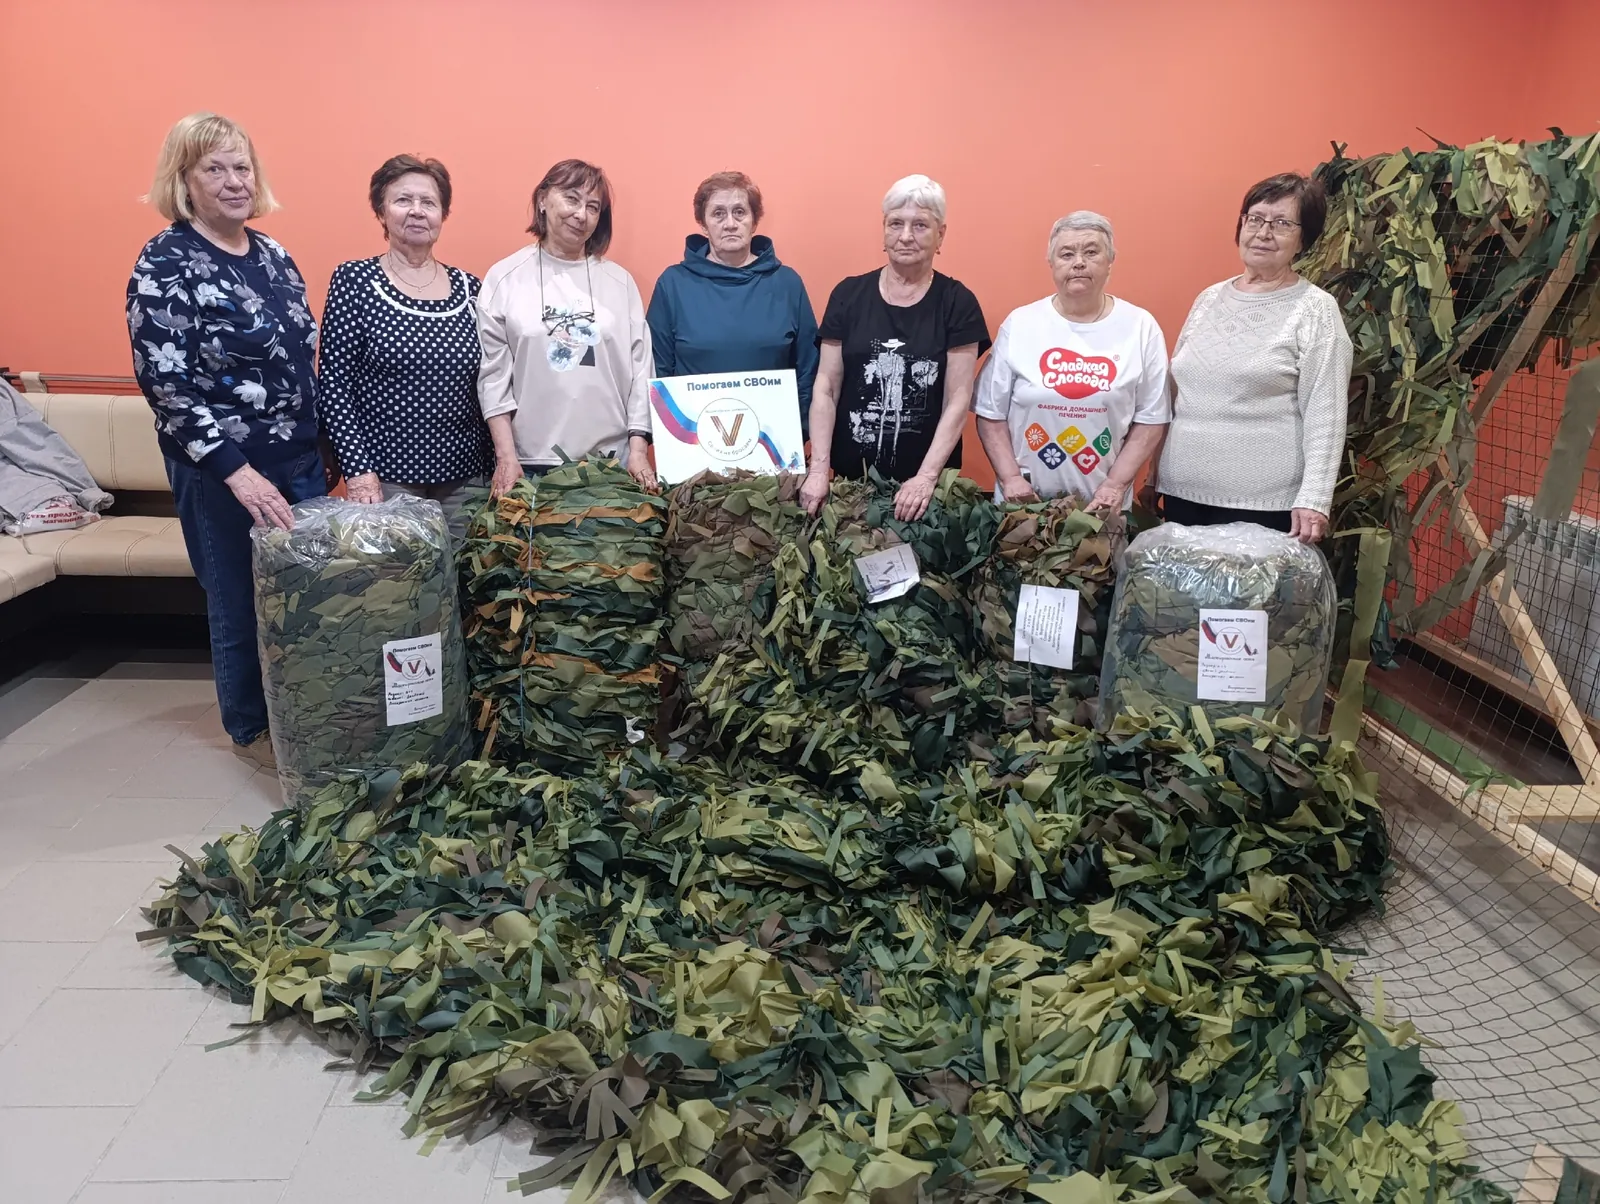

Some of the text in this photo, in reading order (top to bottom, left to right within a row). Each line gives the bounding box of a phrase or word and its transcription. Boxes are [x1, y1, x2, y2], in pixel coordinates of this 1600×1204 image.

[1046, 351, 1109, 376] Сладкая
[687, 377, 782, 391] Помогаем СВОим
[1043, 371, 1110, 391] Слобода
[1037, 403, 1068, 412] ФАБРИКА
